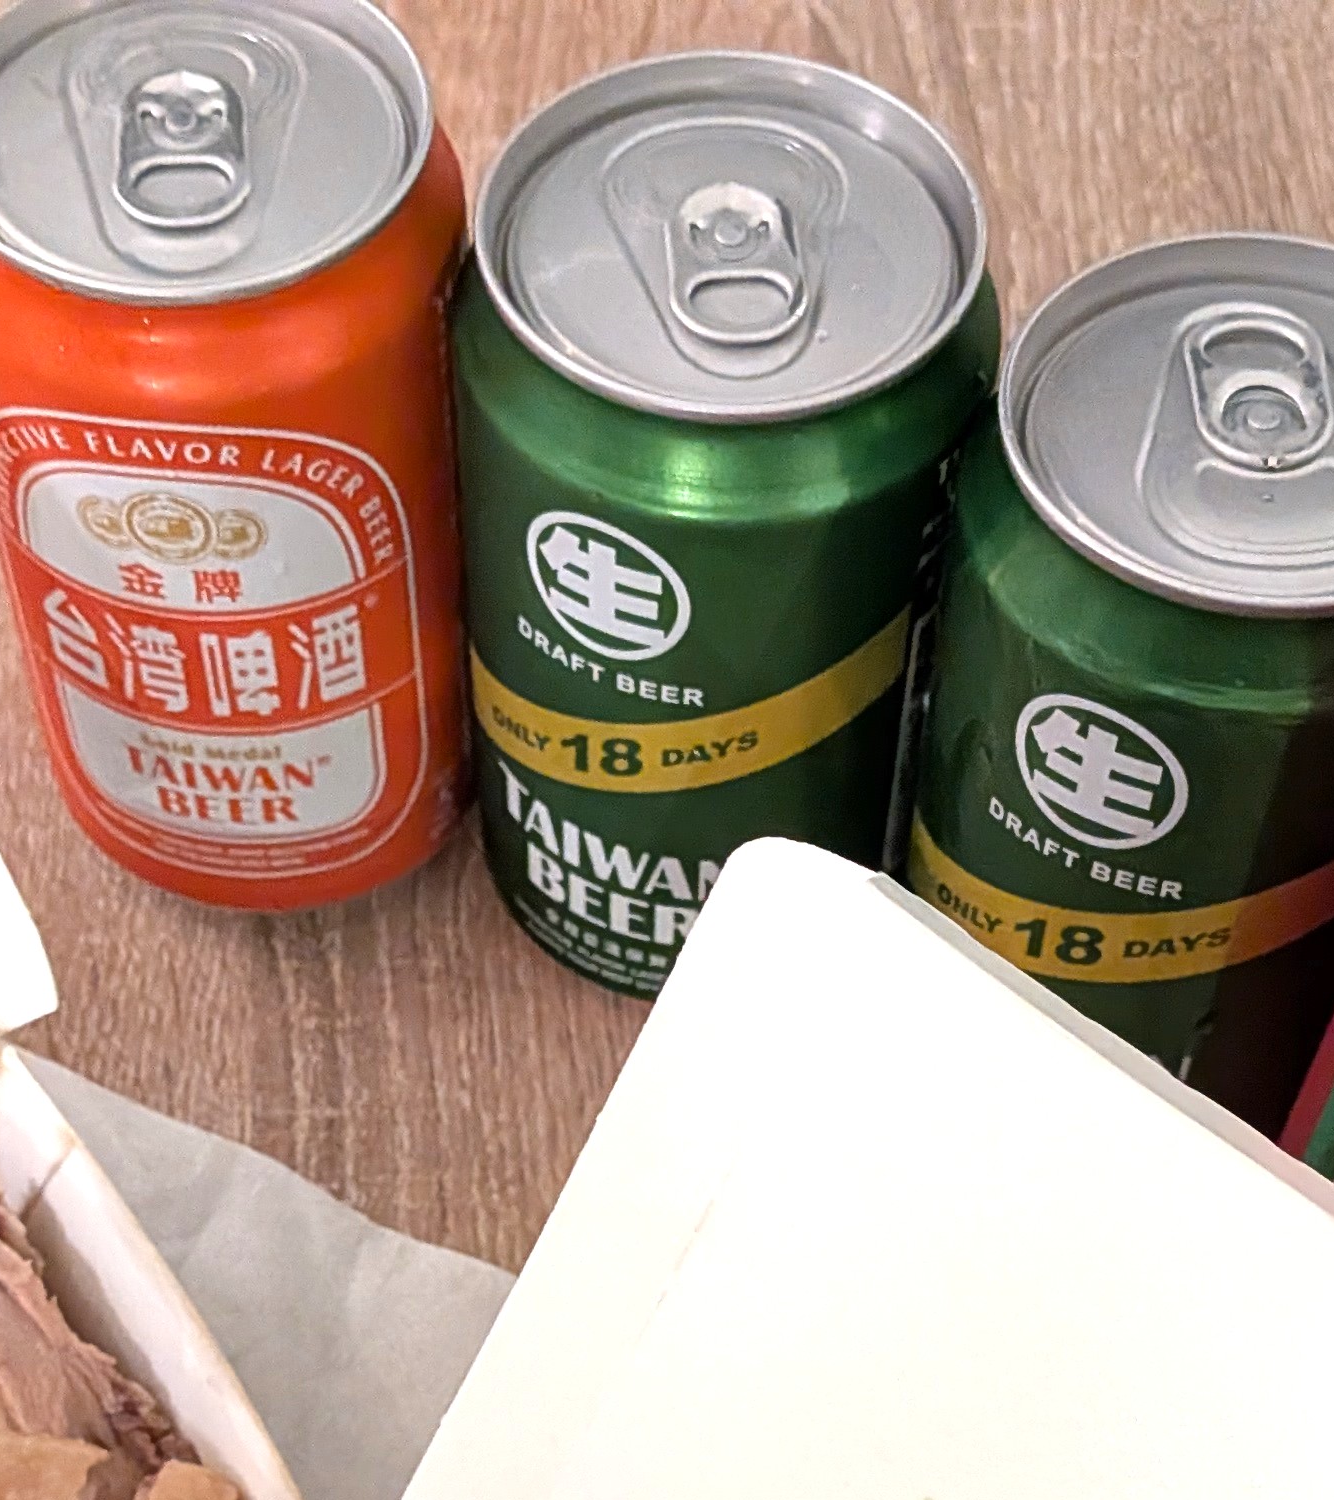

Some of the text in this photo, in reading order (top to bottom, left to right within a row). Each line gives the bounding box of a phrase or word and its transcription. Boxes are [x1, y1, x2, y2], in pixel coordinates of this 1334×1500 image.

[83, 429, 240, 467] FLAVOR
[262, 448, 365, 500] LAGER
[359, 494, 396, 566] BEER
[118, 561, 244, 604] 金牌
[539, 526, 665, 651] 生
[518, 614, 705, 708] DRAFT BEER
[127, 745, 315, 793] TAIWAN
[491, 704, 759, 777] ONLY 18 DAYS
[1031, 708, 1163, 837] 生
[157, 785, 299, 824] BEER
[988, 797, 1184, 900] DRAFT BEER
[526, 841, 703, 946] BEER
[936, 883, 1232, 966] ONLY 18 DAYS
